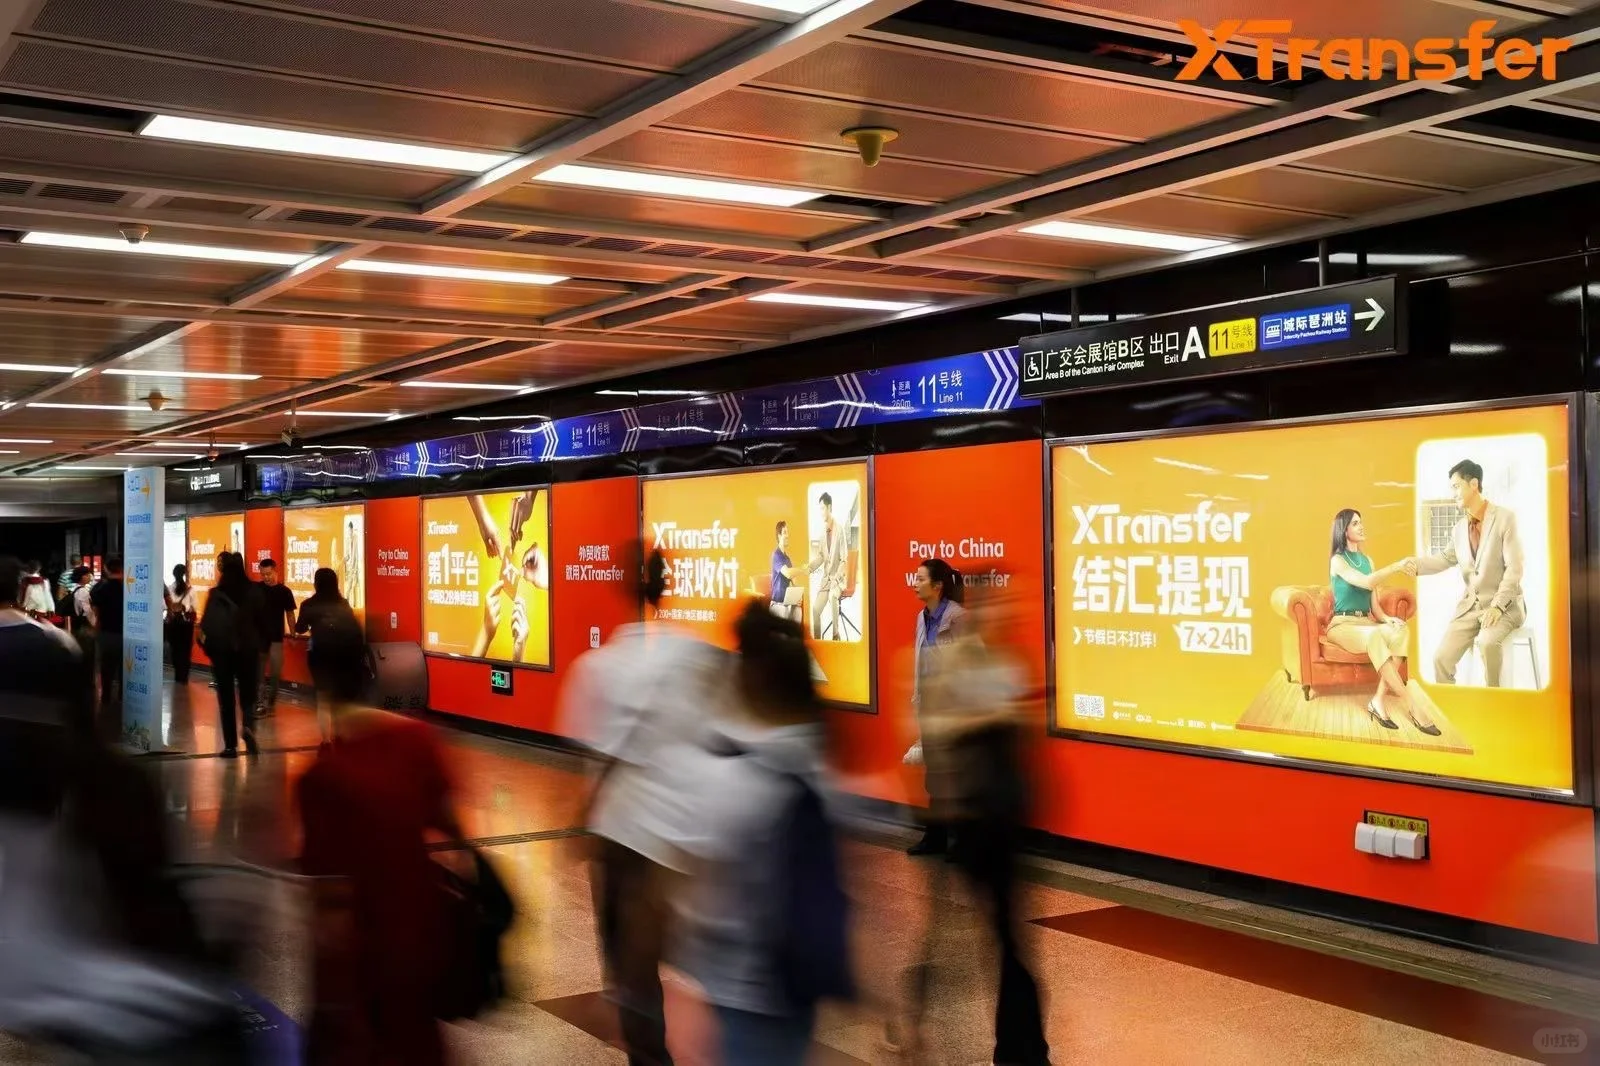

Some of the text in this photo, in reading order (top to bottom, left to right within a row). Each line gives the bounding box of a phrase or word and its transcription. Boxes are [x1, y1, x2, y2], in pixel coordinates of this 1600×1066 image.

[1045, 326, 1206, 370] 广交会展馆B区 出口 A
[1231, 341, 1245, 350] Line
[1045, 360, 1144, 380] Area B of the Canton Fair Complex
[1164, 354, 1179, 365] Exit
[939, 391, 963, 403] Line 11
[652, 520, 739, 549] XTransfer
[1072, 500, 1250, 544] XTransfer
[909, 537, 1004, 560] Pay to China
[428, 543, 479, 586] 第1平台
[1072, 556, 1252, 618] 结汇提现
